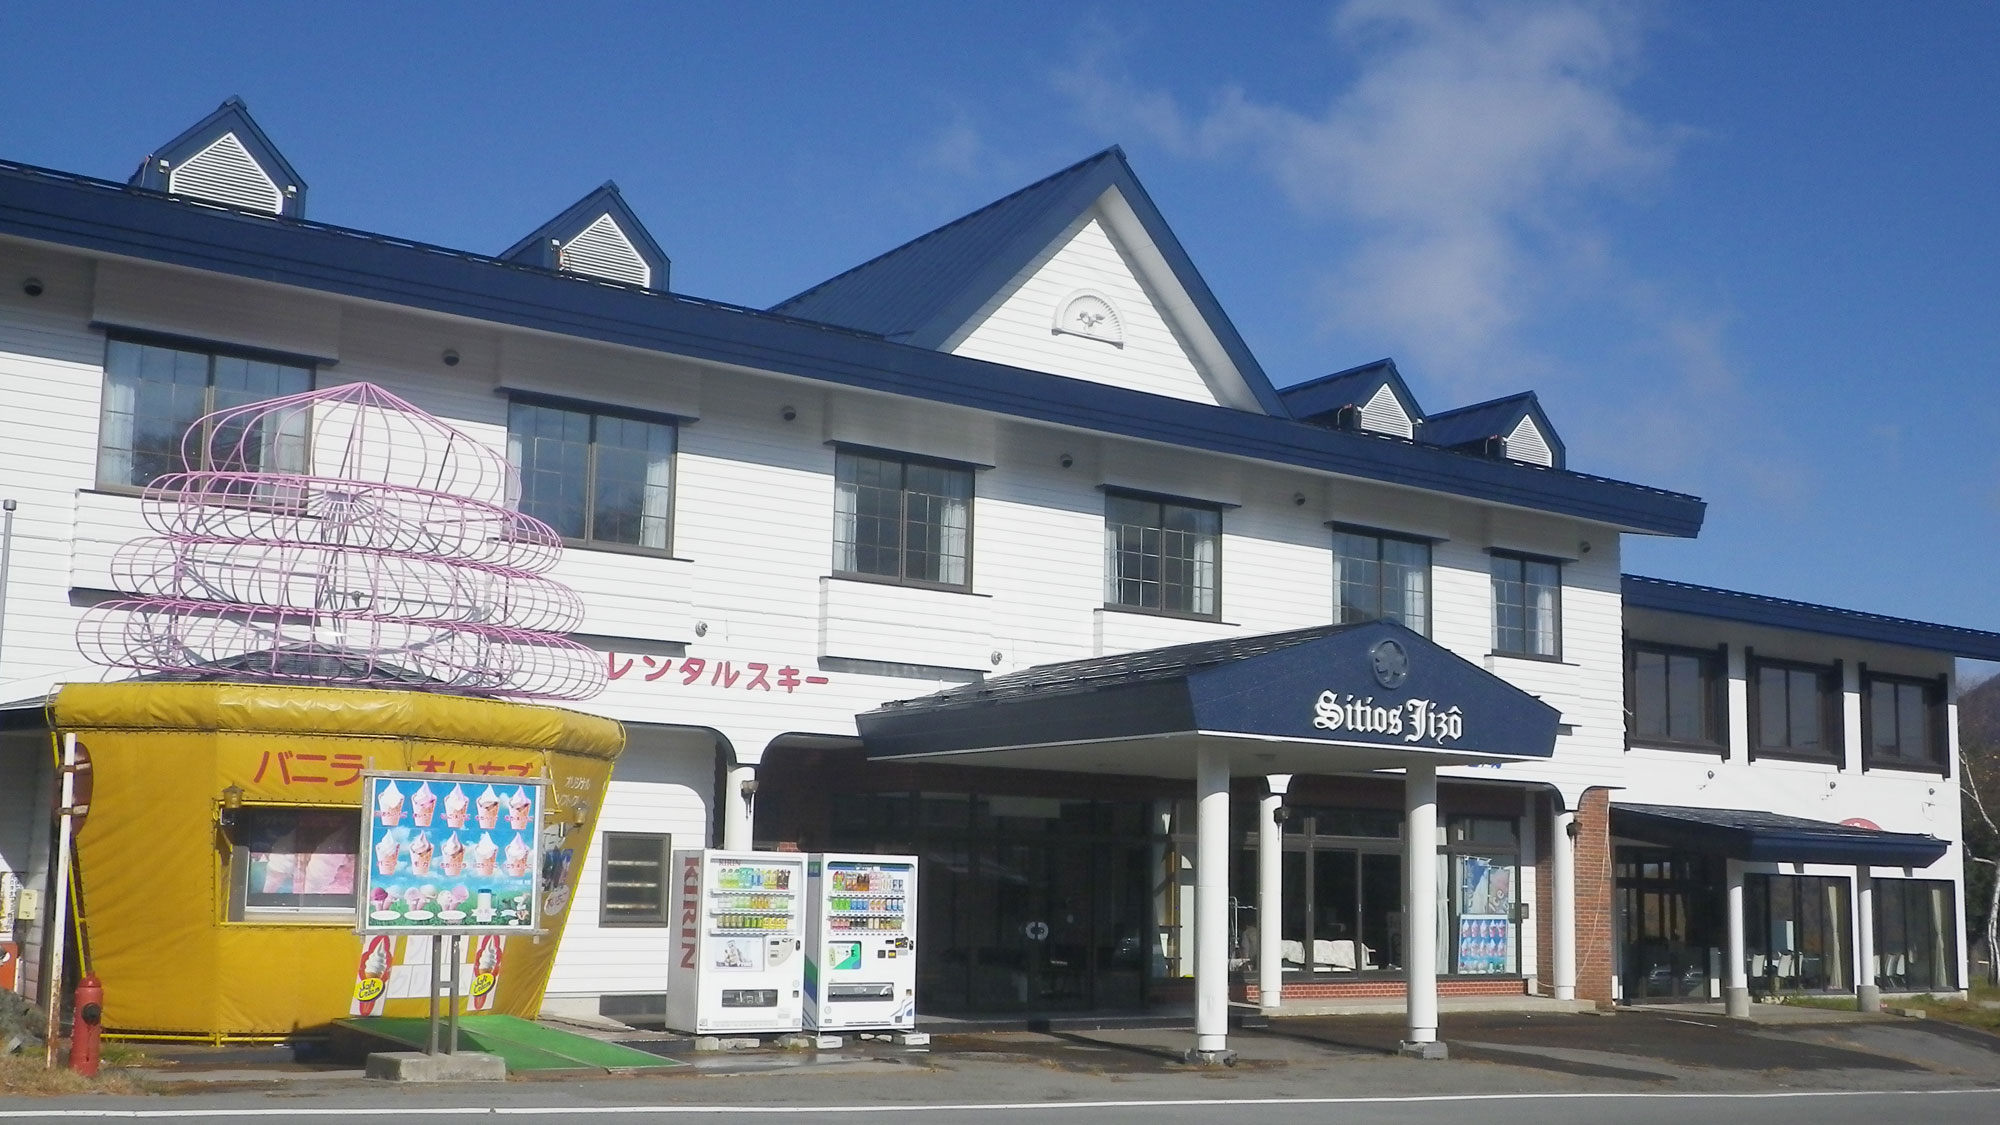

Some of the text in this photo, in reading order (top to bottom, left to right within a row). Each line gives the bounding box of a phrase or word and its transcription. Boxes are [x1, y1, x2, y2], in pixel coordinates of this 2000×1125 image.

[607, 651, 829, 693] レンタルスキー
[1313, 690, 1463, 745] Sitios Jizô
[253, 750, 364, 786] バニラ
[681, 856, 700, 969] KIRIN
